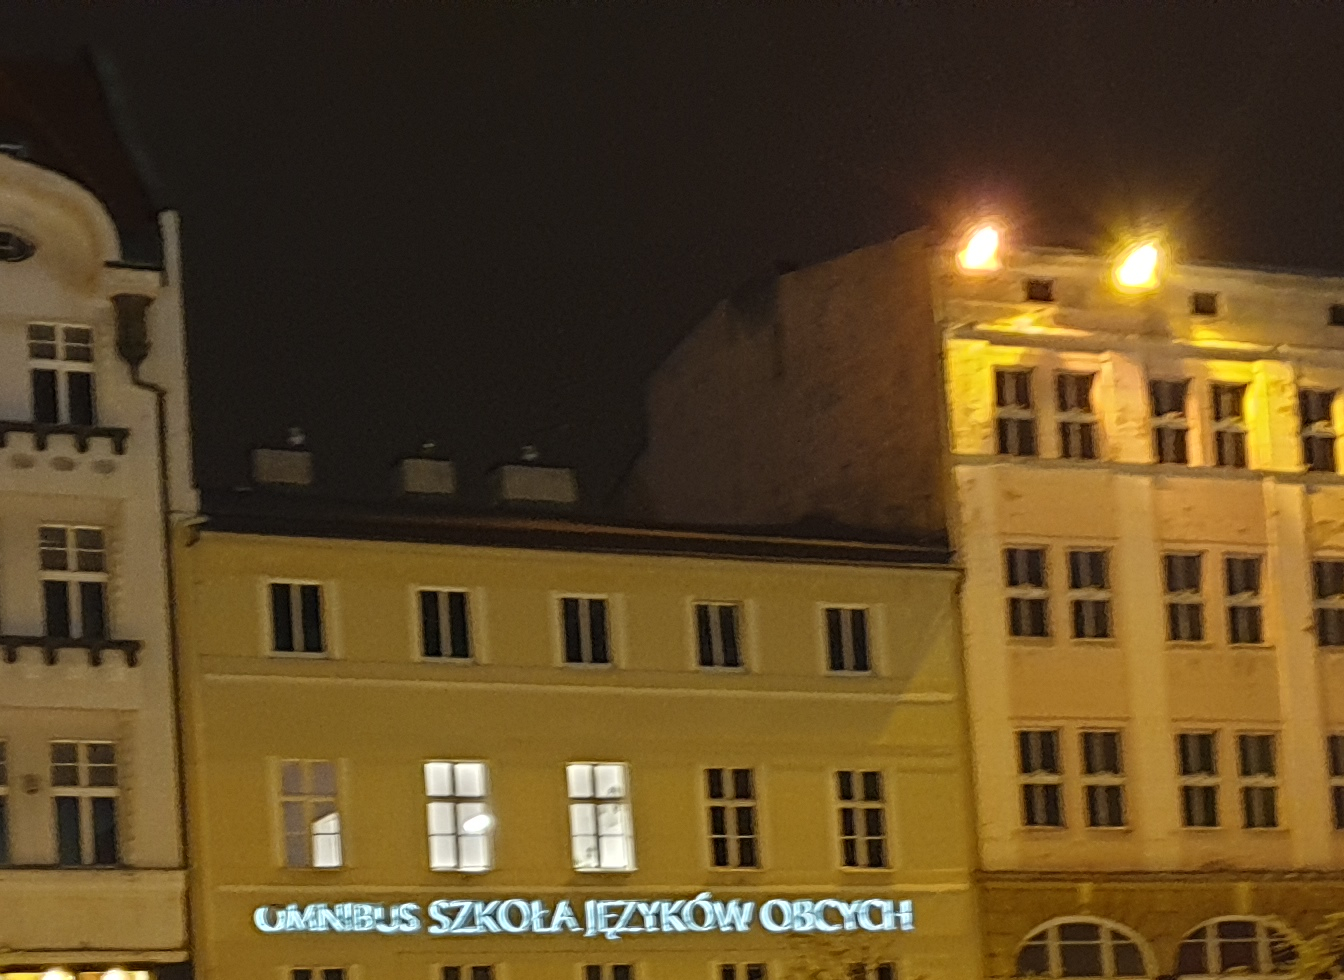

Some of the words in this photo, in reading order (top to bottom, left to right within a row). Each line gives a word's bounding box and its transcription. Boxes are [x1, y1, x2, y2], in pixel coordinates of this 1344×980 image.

[253, 902, 422, 933] OMNIBUS
[427, 899, 584, 935] SZKOŁA
[584, 891, 755, 940] JĘZYKÓW
[759, 898, 915, 932] OBCYCH
